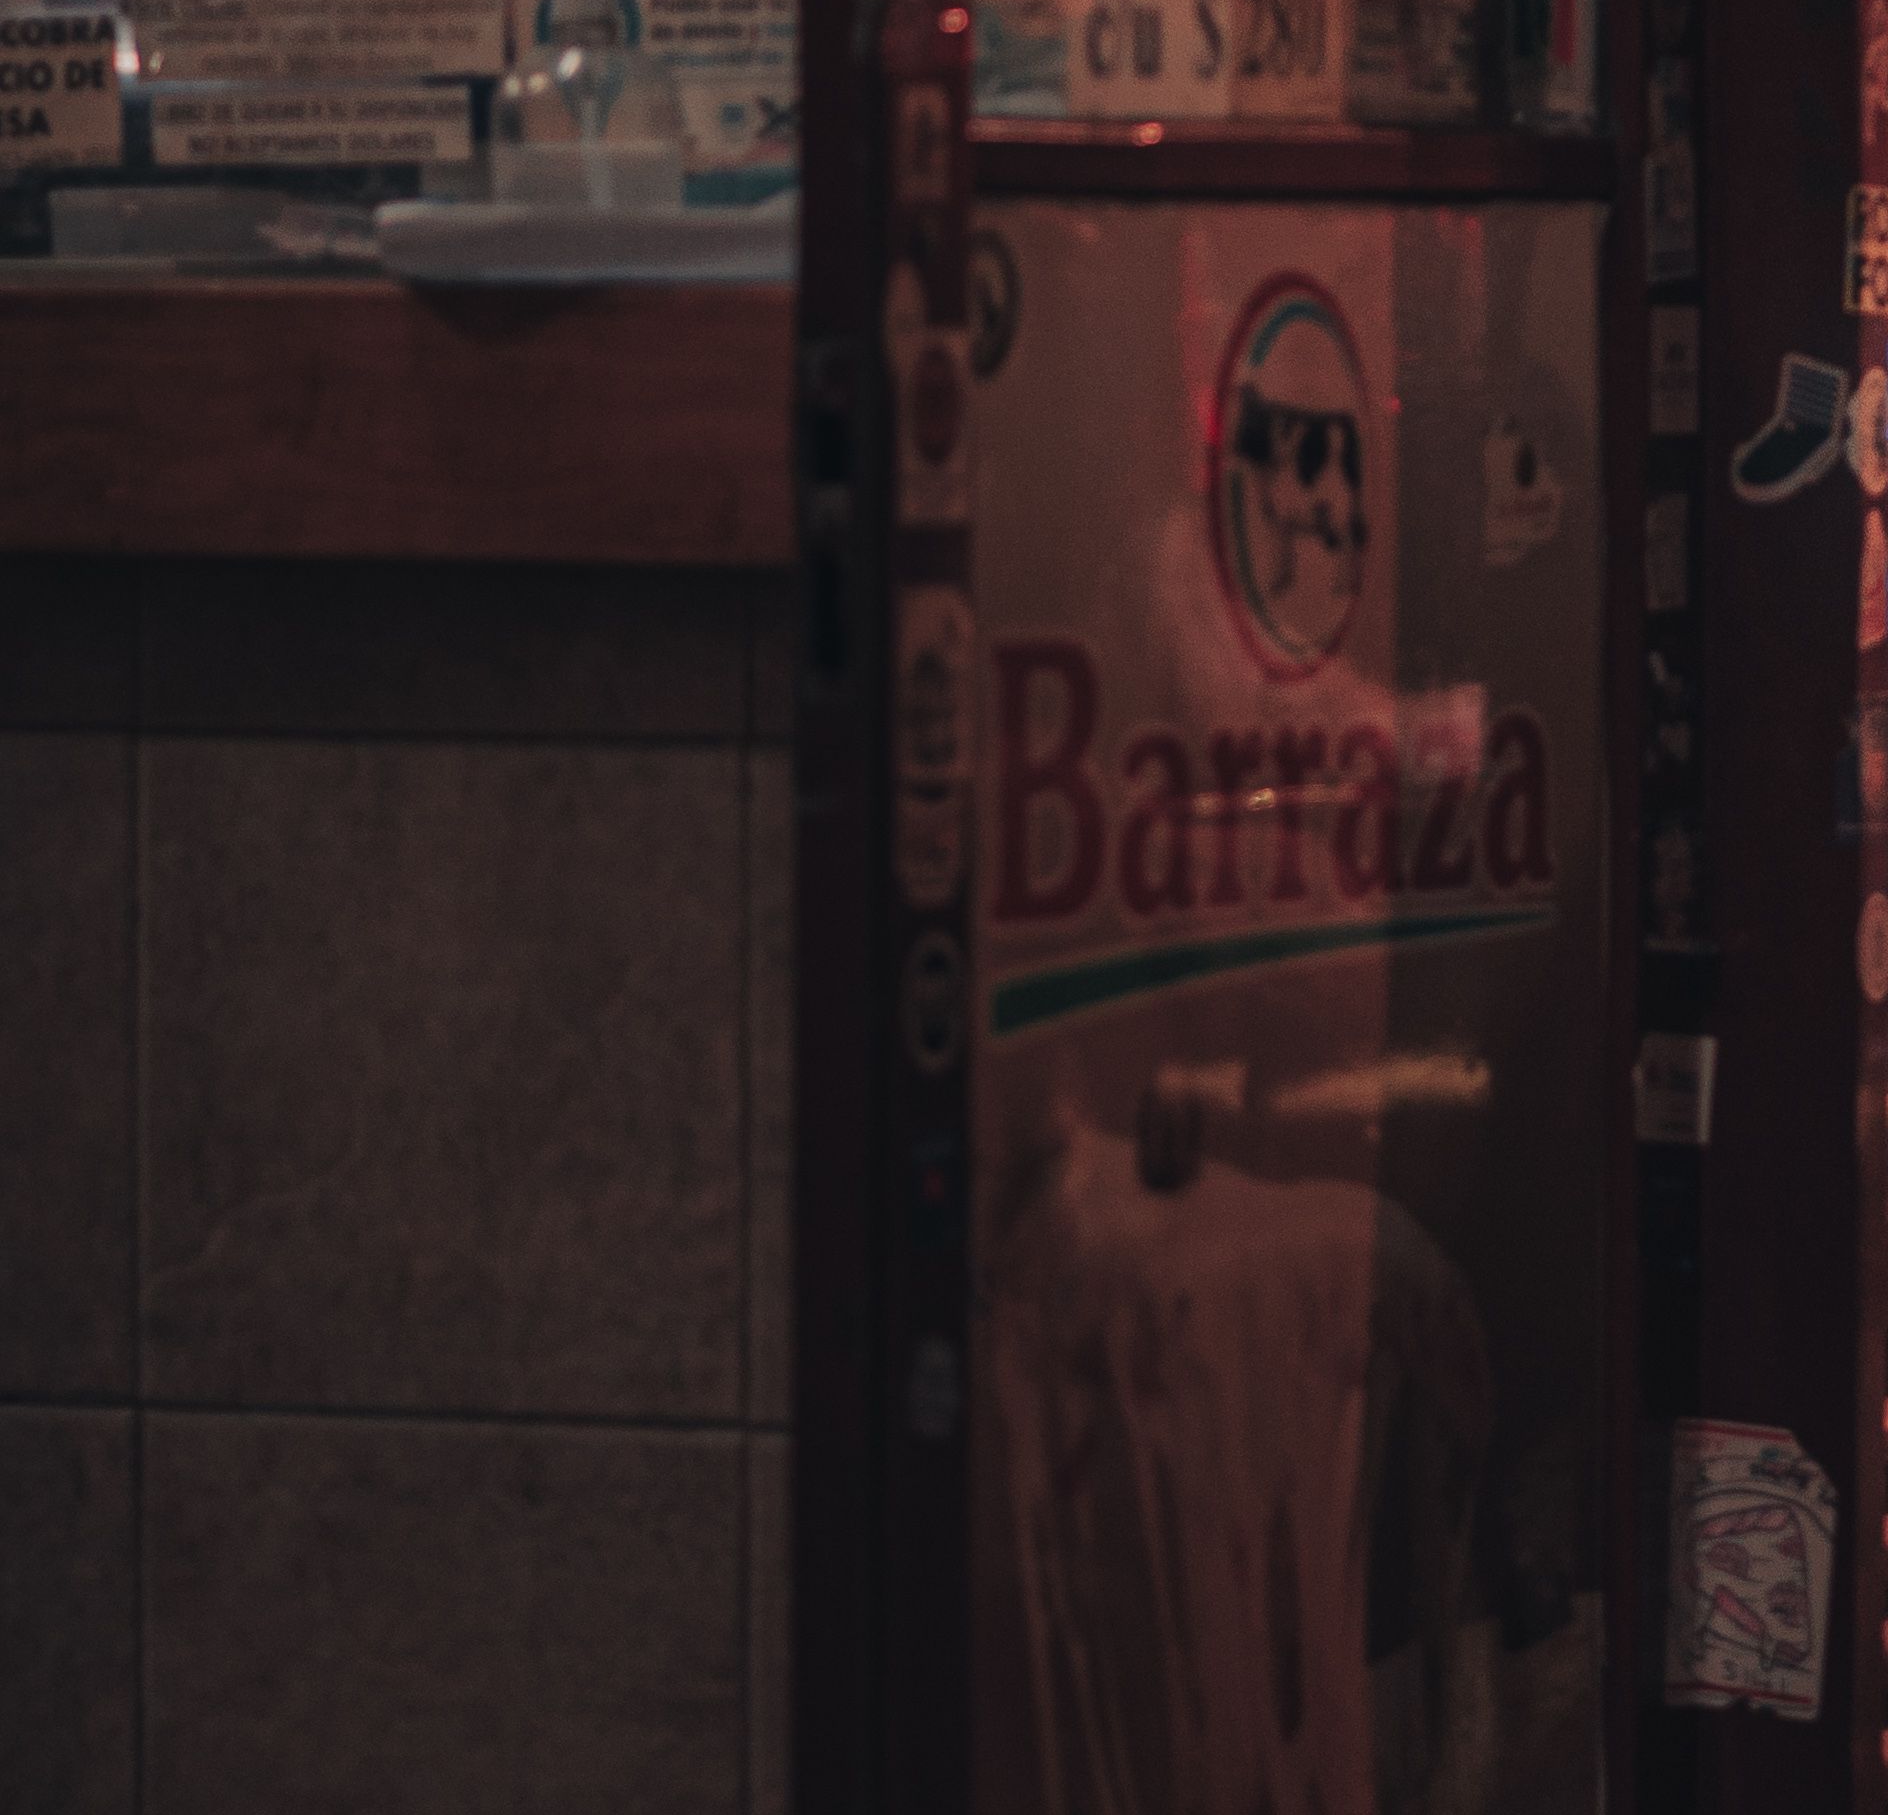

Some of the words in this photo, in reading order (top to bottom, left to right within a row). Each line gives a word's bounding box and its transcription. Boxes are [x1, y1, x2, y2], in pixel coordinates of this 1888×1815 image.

[0, 15, 115, 48] COBRA
[64, 59, 105, 90] DE
[993, 639, 1554, 924] Barraza
